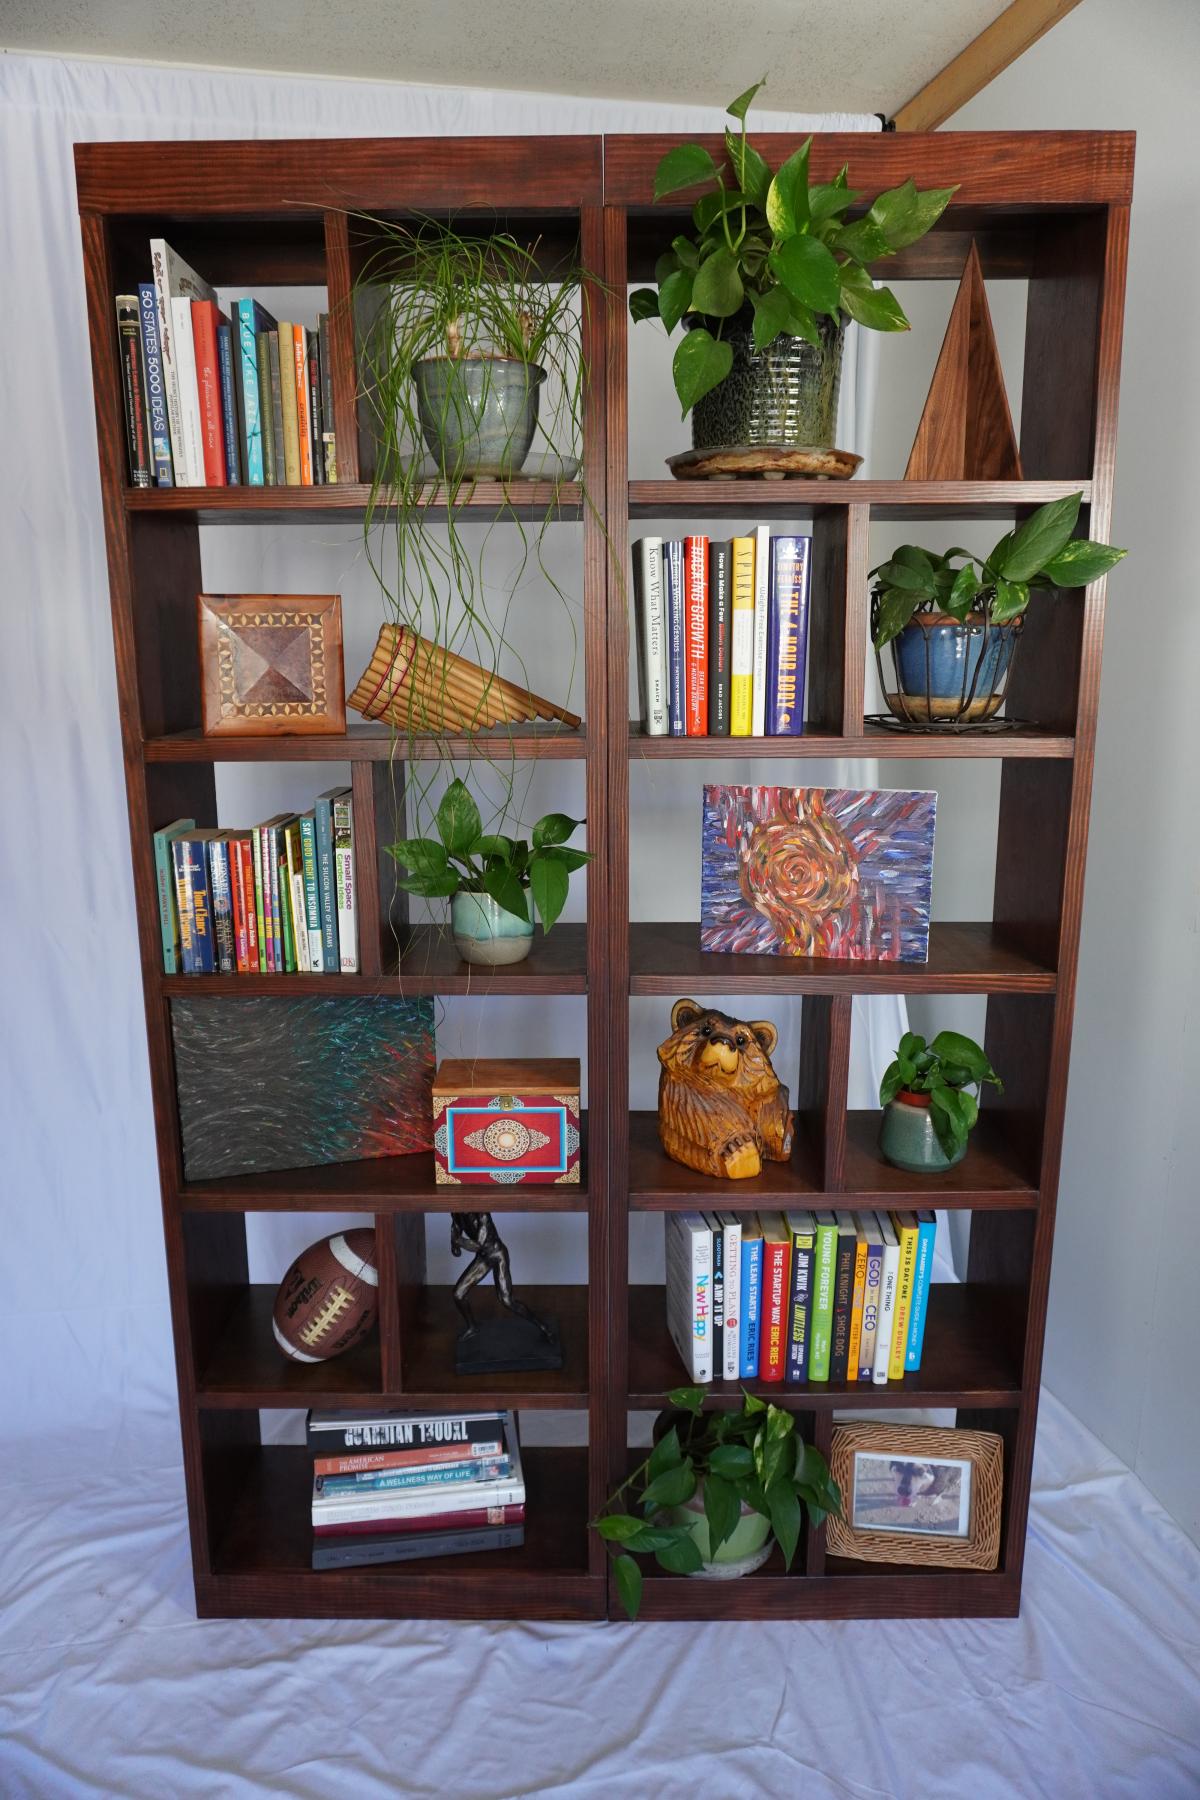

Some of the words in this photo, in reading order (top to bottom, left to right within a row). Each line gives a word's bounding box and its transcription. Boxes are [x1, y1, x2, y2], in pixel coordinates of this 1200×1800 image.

[142, 290, 153, 308] 50
[144, 311, 156, 354] STATES
[242, 312, 253, 347] BLUE
[148, 357, 162, 394] 5000
[203, 367, 211, 378] the
[244, 354, 254, 386] LIKE
[202, 380, 211, 408] pleasure
[152, 397, 164, 432] IDEAS
[246, 393, 256, 424] JAZZ
[298, 402, 307, 437] creativity
[649, 548, 659, 578] Know
[690, 547, 706, 602] HACKING
[717, 570, 725, 578] to
[736, 552, 752, 600] SPARK
[650, 582, 660, 611] What
[673, 588, 681, 623] WORKING
[757, 586, 766, 630] Weight-Free
[780, 592, 799, 615] THE
[650, 615, 661, 656] Matters
[691, 604, 704, 658] GROWTH
[777, 676, 796, 709] BODY
[303, 823, 311, 835] SAY
[304, 838, 313, 856] GOOD
[306, 859, 315, 880] NIGHT
[193, 890, 207, 907] Tom
[307, 883, 315, 891] TO
[344, 882, 352, 910] Space
[193, 909, 208, 935] Clancy
[308, 894, 317, 928] INSOMNIA
[180, 913, 193, 949] Remorse
[215, 920, 224, 943] DUTY
[223, 920, 232, 954] SOLEMN
[729, 1234, 740, 1278] GETTING
[750, 1246, 758, 1262] THE
[773, 1250, 782, 1267] THE
[822, 1231, 832, 1264] YOUNG
[798, 1253, 809, 1268] JIM
[841, 1253, 850, 1271] PHIL
[856, 1253, 866, 1278] ZERO
[868, 1259, 880, 1287] GOD
[750, 1264, 758, 1285] LEAN
[772, 1268, 782, 1305] STARTUP
[796, 1269, 807, 1290] KWIK
[696, 1275, 709, 1303] New
[714, 1284, 722, 1302] AMP
[819, 1266, 831, 1310] FOREVER
[840, 1274, 849, 1304] KNIGHT
[714, 1304, 722, 1312] IT
[729, 1291, 740, 1316] PLAN
[749, 1286, 758, 1321] STARTUP
[771, 1306, 780, 1324] WAY
[693, 1305, 708, 1341] Happy
[714, 1315, 722, 1326] UP
[793, 1304, 806, 1342] LIMITLESS
[836, 1315, 846, 1337] SHOE
[865, 1305, 876, 1330] CEO
[748, 1323, 756, 1342] ERIC
[770, 1326, 780, 1345] ERIC
[896, 1330, 904, 1359] DUDLEY
[747, 1344, 755, 1362] RIES
[770, 1347, 779, 1364] RIES
[835, 1339, 844, 1356] DOG
[344, 1425, 413, 1446] GUARDIAN
[419, 1421, 468, 1442] 1300XL
[339, 1464, 368, 1472] PROMISE
[349, 1455, 384, 1465] AMERICAN
[388, 1474, 426, 1485] WELLNESS
[427, 1472, 442, 1480] WAY
